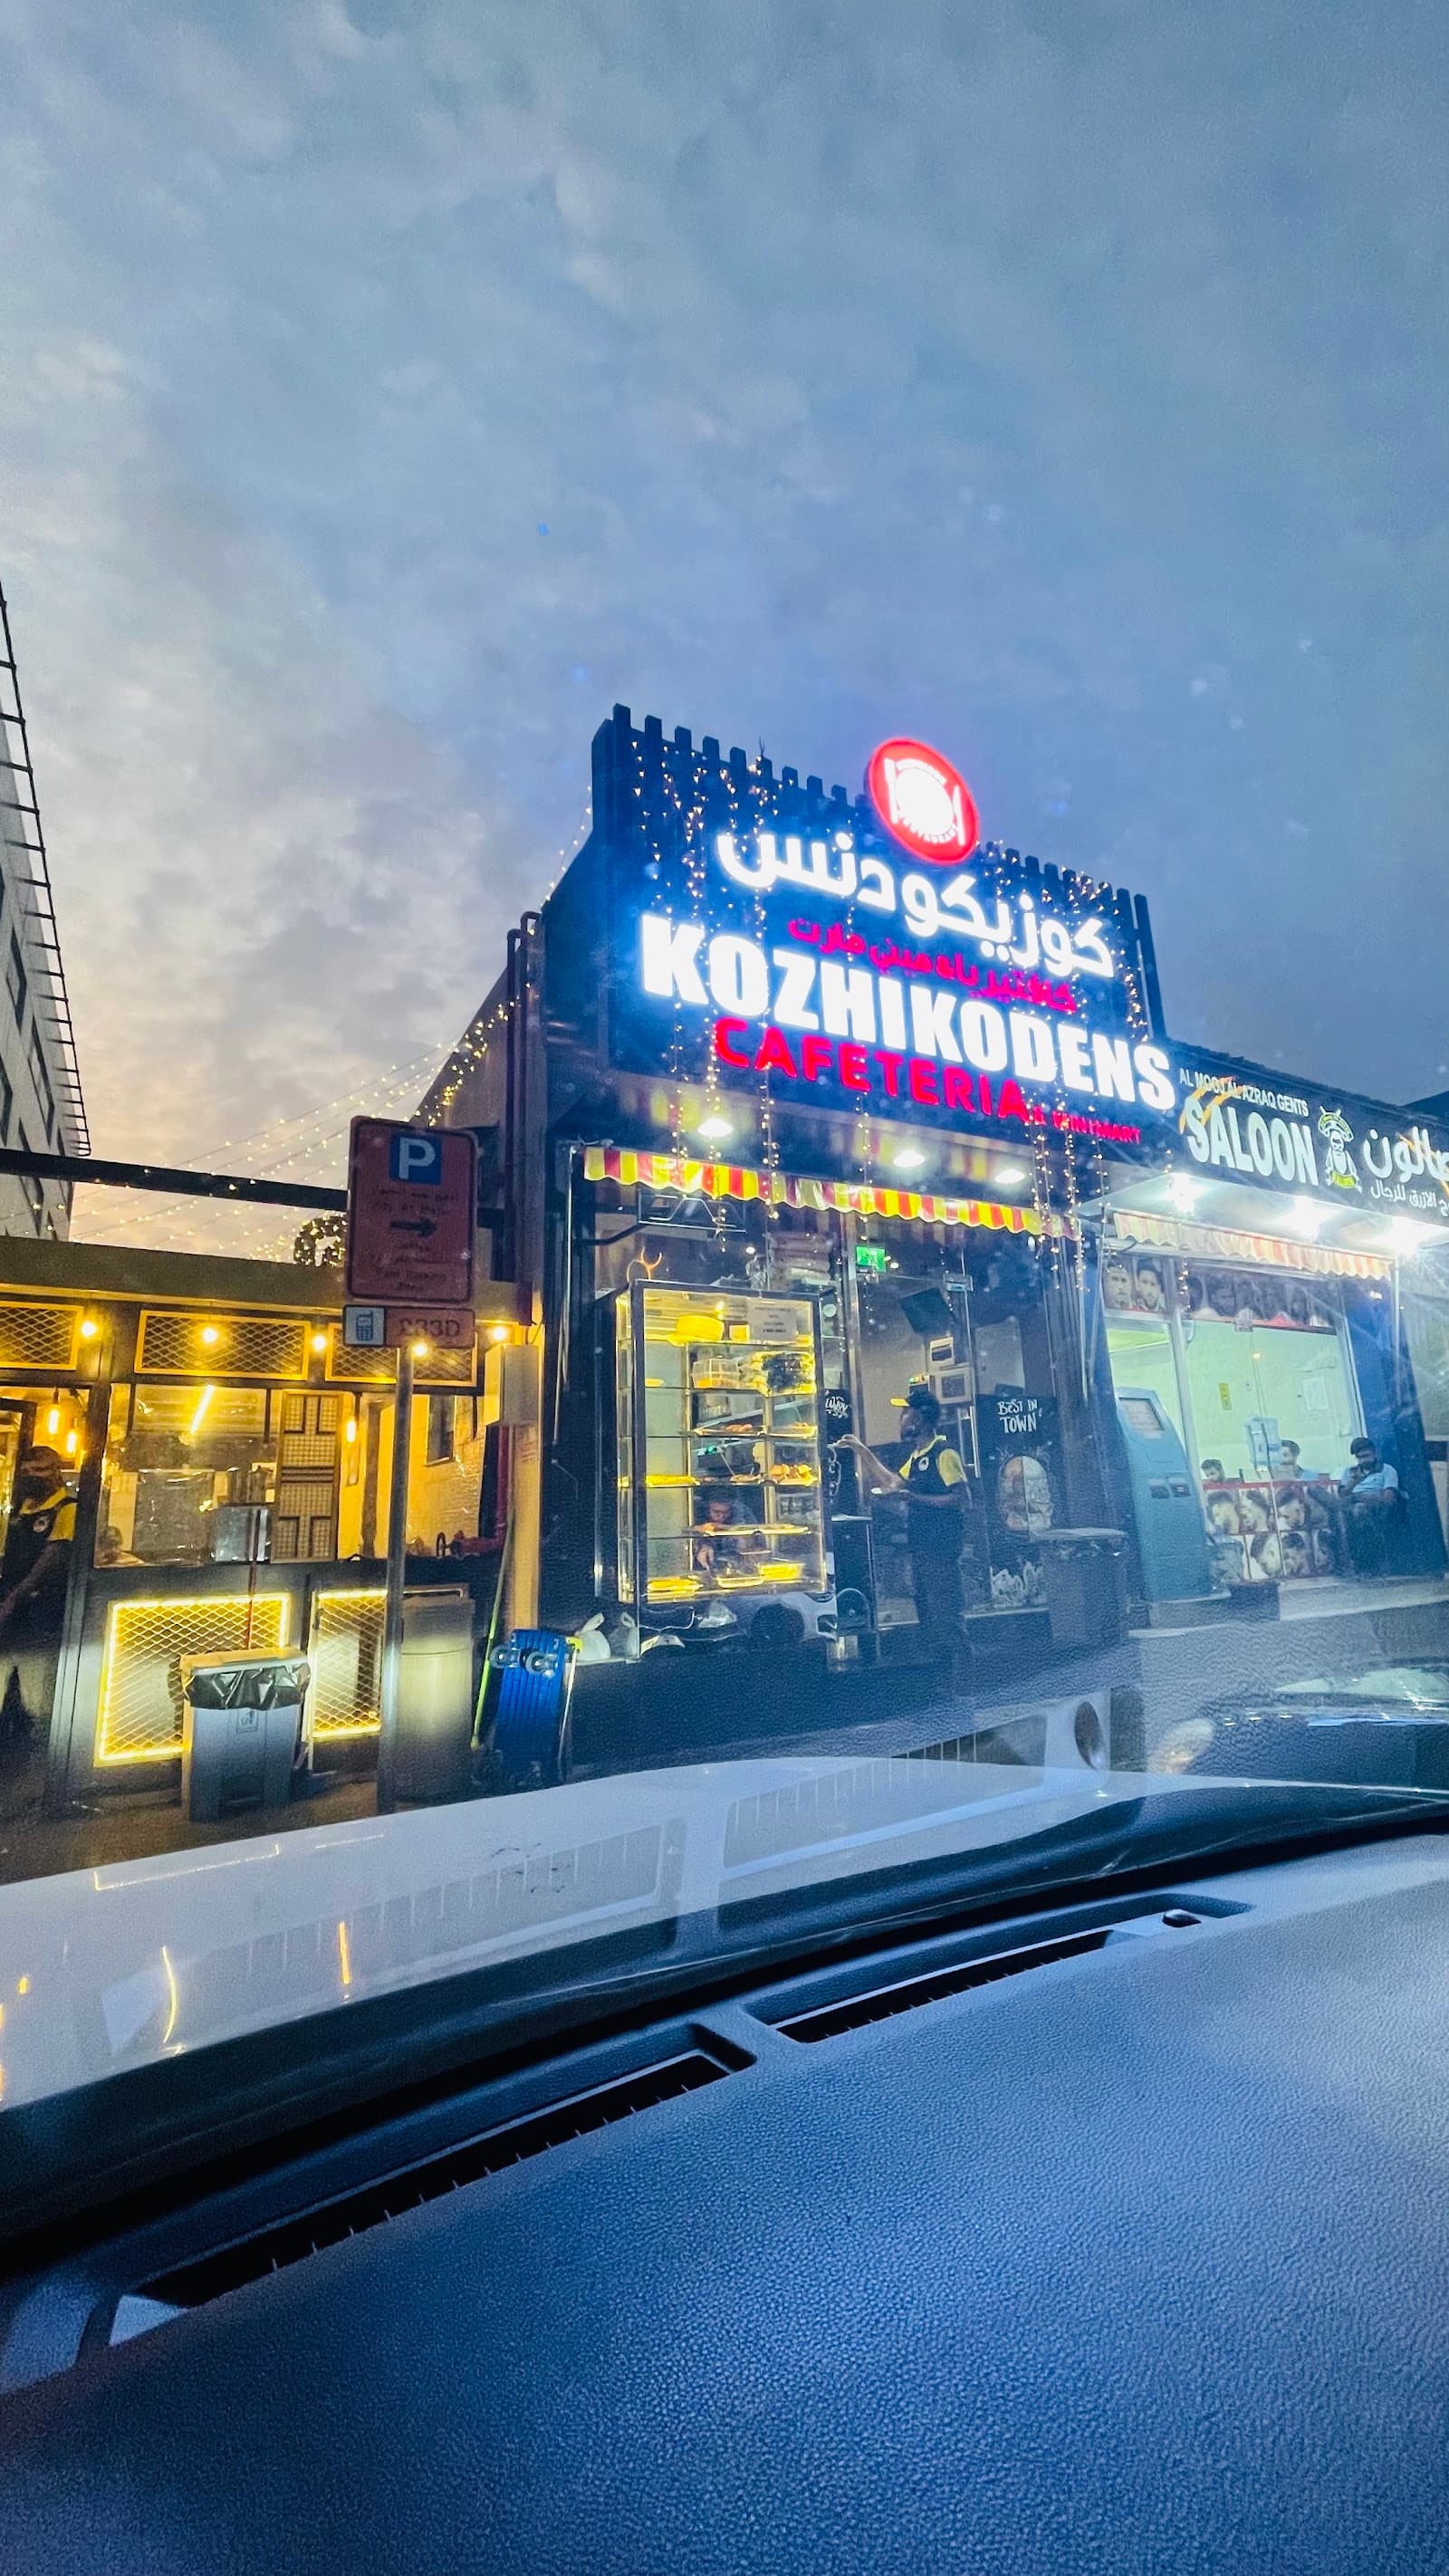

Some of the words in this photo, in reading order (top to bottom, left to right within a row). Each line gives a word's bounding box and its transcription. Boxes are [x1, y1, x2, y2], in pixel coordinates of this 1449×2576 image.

[717, 831, 1115, 979] كوزيكودنس
[641, 913, 1175, 1110] KOZHIKODENS
[714, 1016, 1030, 1124] CAFETERIA
[1179, 1068, 1195, 1087] AL
[1227, 1081, 1242, 1100] AL
[1242, 1084, 1276, 1110] AZRAQ
[1277, 1093, 1310, 1117] GENTS
[398, 1137, 436, 1179] P
[1184, 1096, 1319, 1186] SALOON
[1370, 1178, 1406, 1202] للرجال
[1027, 1399, 1038, 1412] IN
